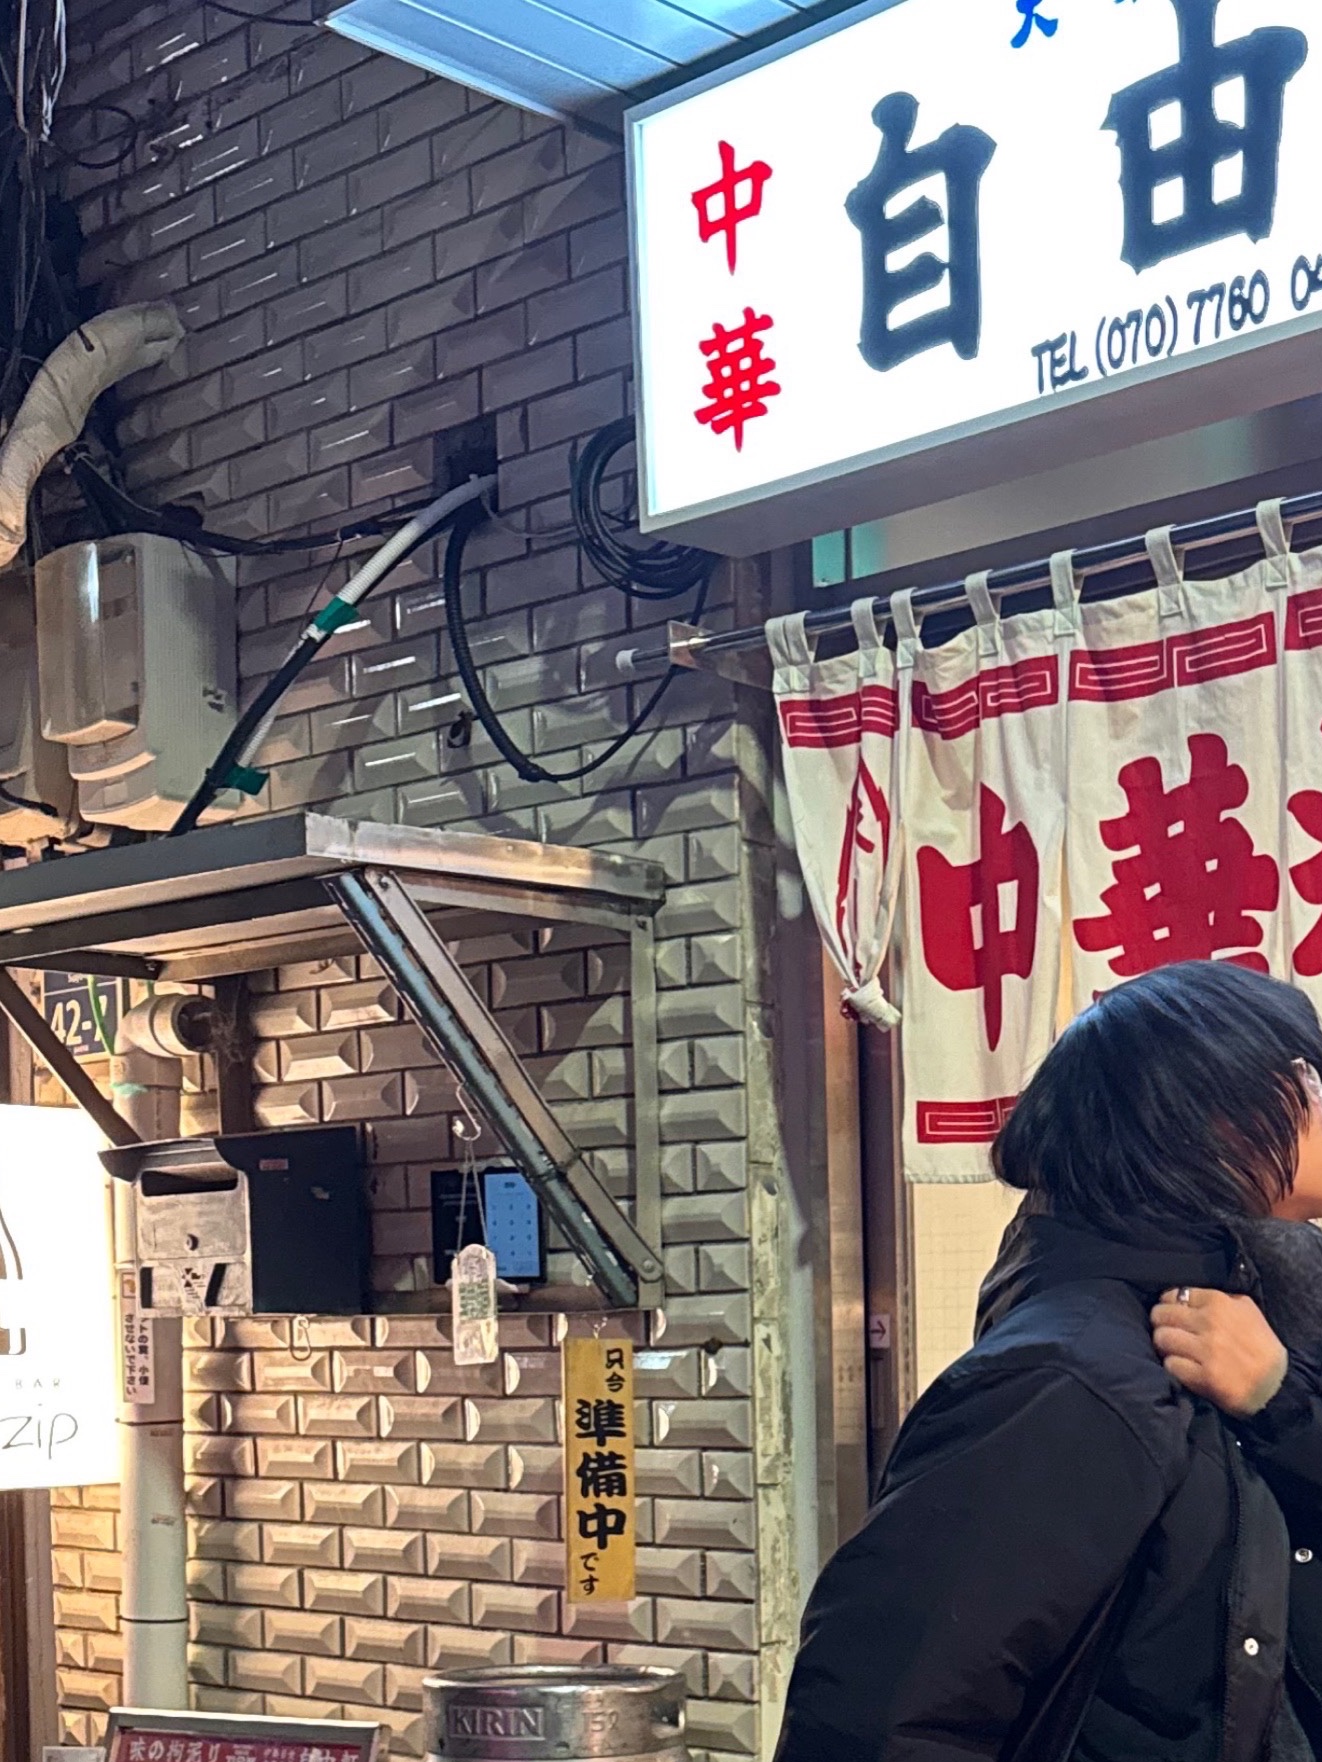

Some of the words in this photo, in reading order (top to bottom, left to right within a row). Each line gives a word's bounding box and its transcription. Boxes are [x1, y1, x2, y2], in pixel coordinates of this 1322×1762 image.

[691, 139, 782, 453] 中華
[1030, 330, 1089, 394] TEL
[1095, 295, 1179, 378] (070)
[1187, 269, 1271, 345] 7760
[575, 1347, 628, 1596] 只今準備中です
[452, 1707, 542, 1738] KIRIN
